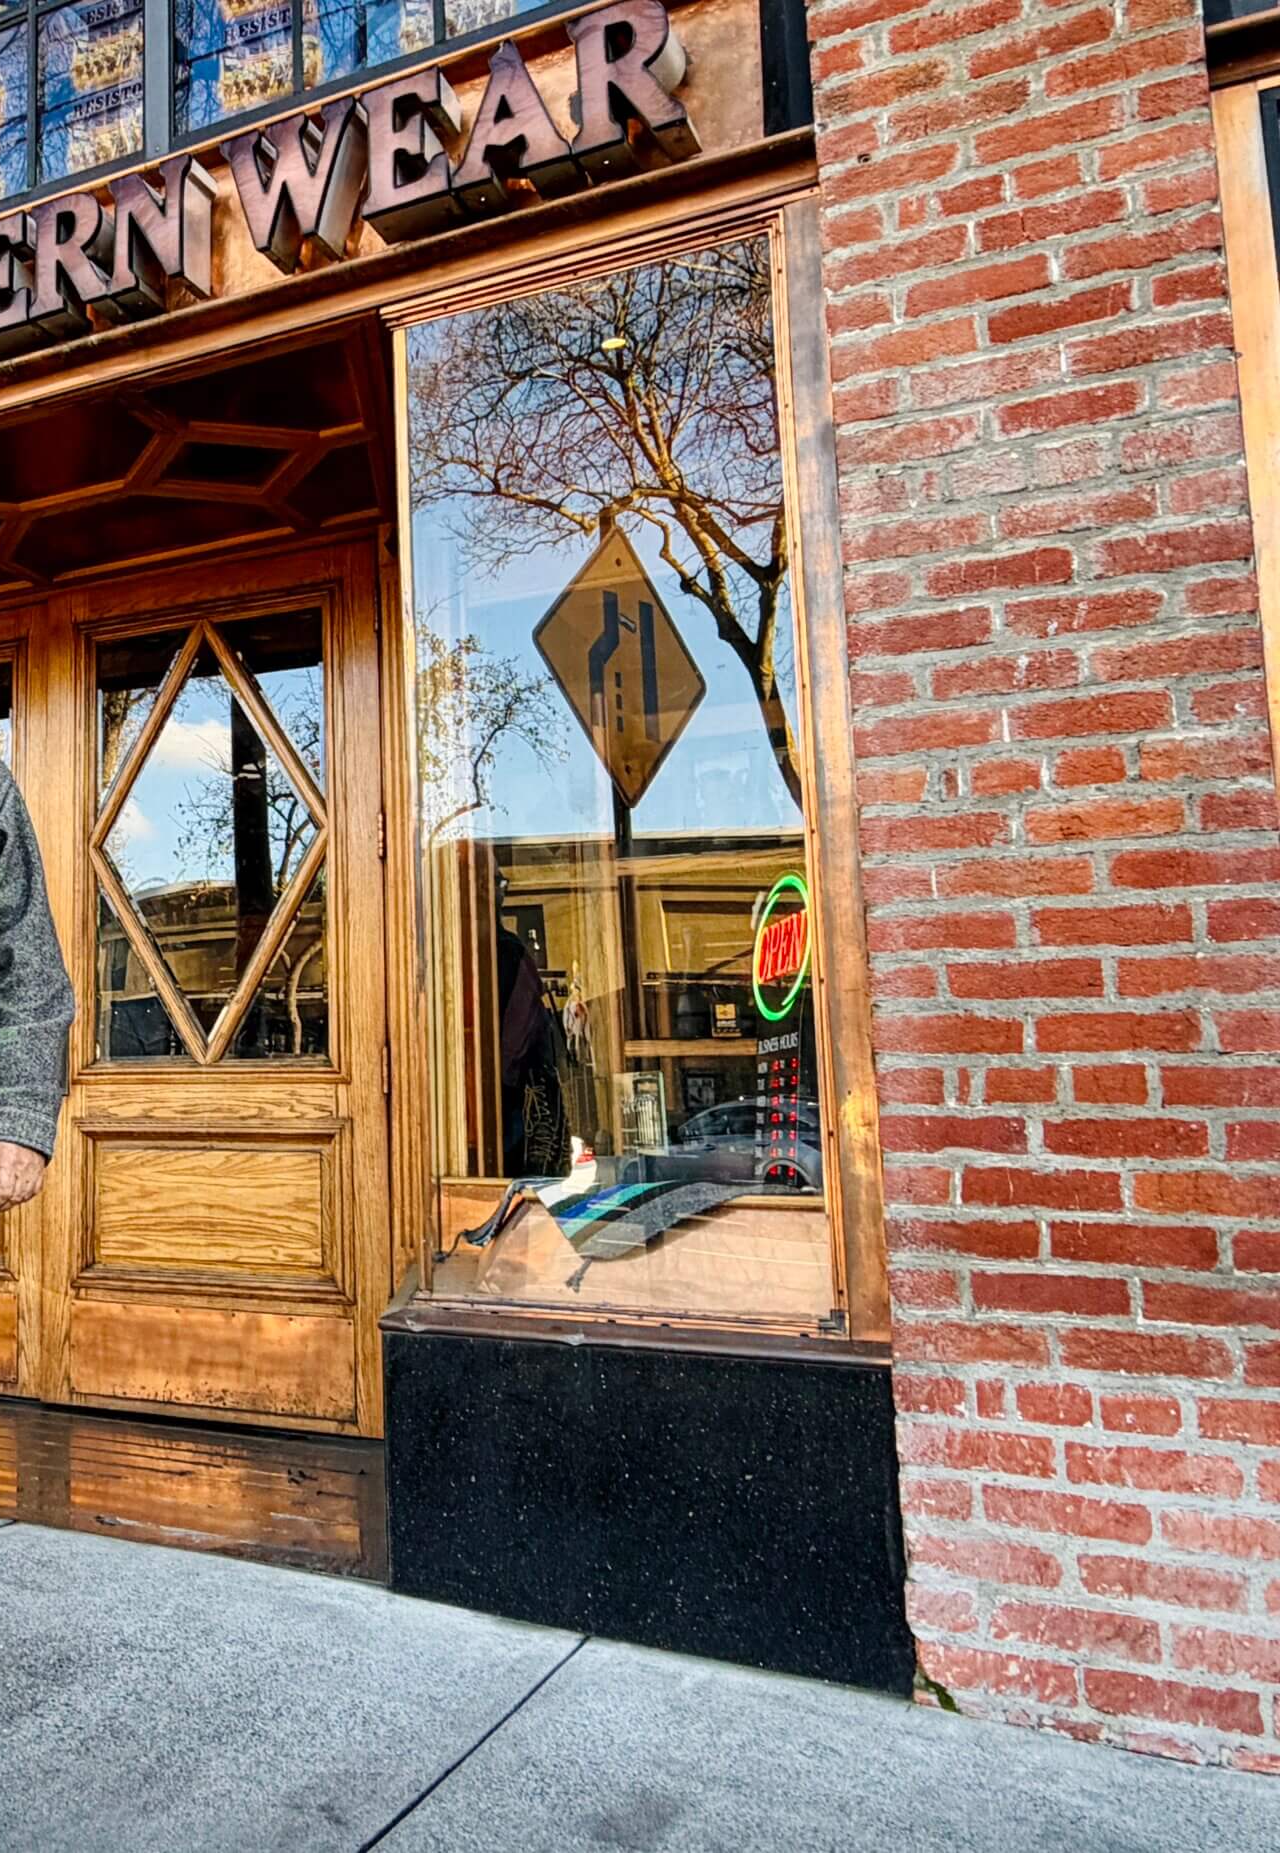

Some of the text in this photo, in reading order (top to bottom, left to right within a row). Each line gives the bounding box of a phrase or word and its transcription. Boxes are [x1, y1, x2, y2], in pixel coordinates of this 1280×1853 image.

[74, 82, 143, 117] RESISTO
[220, 0, 688, 254] WEAR
[757, 909, 808, 985] OPEN
